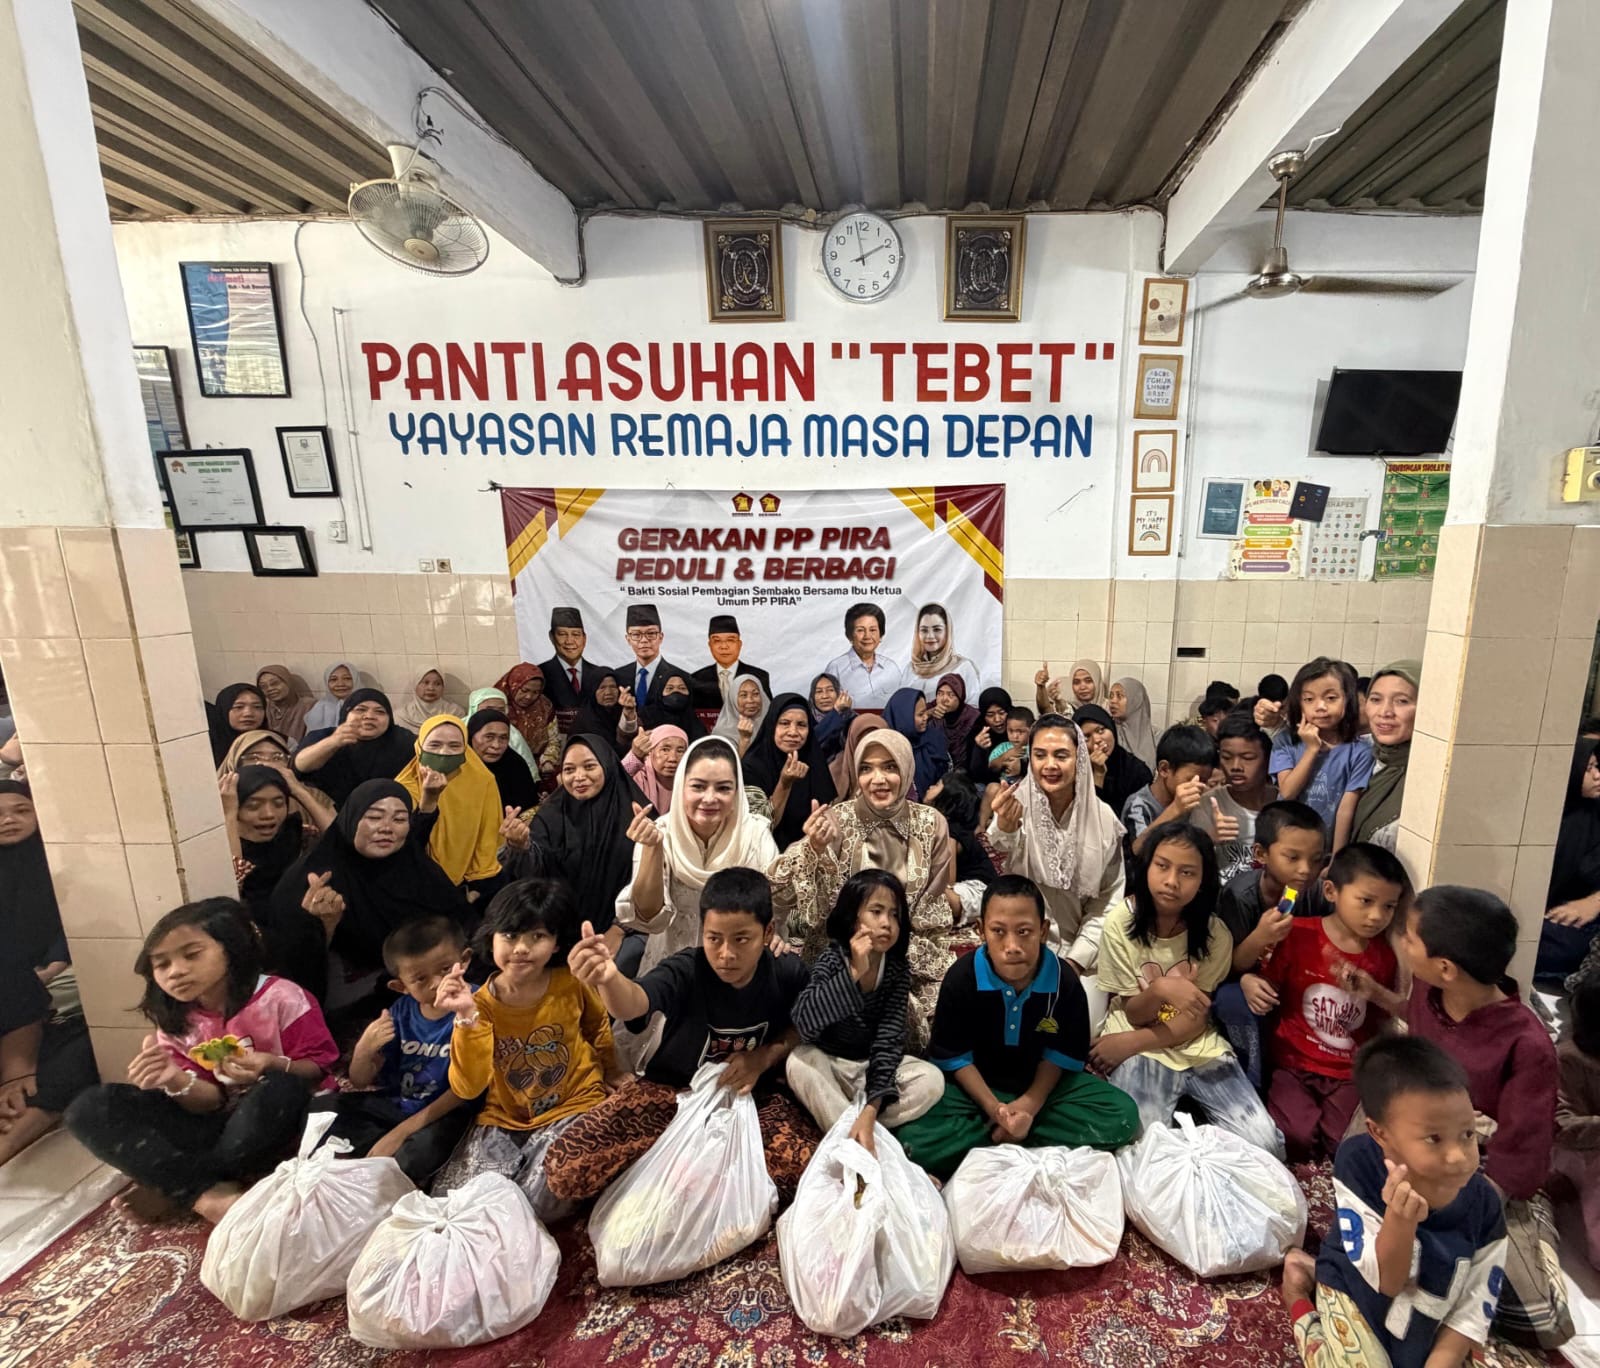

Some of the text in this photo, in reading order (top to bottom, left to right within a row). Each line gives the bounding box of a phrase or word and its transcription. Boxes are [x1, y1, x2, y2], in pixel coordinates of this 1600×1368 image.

[846, 225, 853, 236] 11
[858, 221, 870, 232] 12
[876, 227, 880, 237] 1
[835, 235, 846, 246] 10
[884, 238, 892, 249] 2
[829, 250, 838, 261] 9
[888, 254, 896, 265] 3
[833, 267, 841, 277] 8
[882, 270, 890, 280] 4
[843, 279, 851, 289] 7
[858, 284, 866, 294] 6
[871, 281, 880, 291] 5
[361, 342, 547, 401] PANTI
[557, 342, 815, 402] ASUHAN
[389, 412, 1093, 458] YAYASAN REMAJA MASA DEPAN
[617, 526, 892, 551] GERAKAN PP PIRA
[616, 556, 897, 581] PEDULI & BERBAGI
[628, 586, 655, 596] Bakti
[657, 586, 690, 596] Sosial
[692, 586, 750, 599] Pembagian
[752, 585, 801, 596] Sembako
[803, 586, 849, 596] Bersama
[851, 586, 868, 596] Ibu
[870, 585, 902, 595] Ketua
[717, 597, 750, 606] Umum
[752, 596, 767, 606] PP
